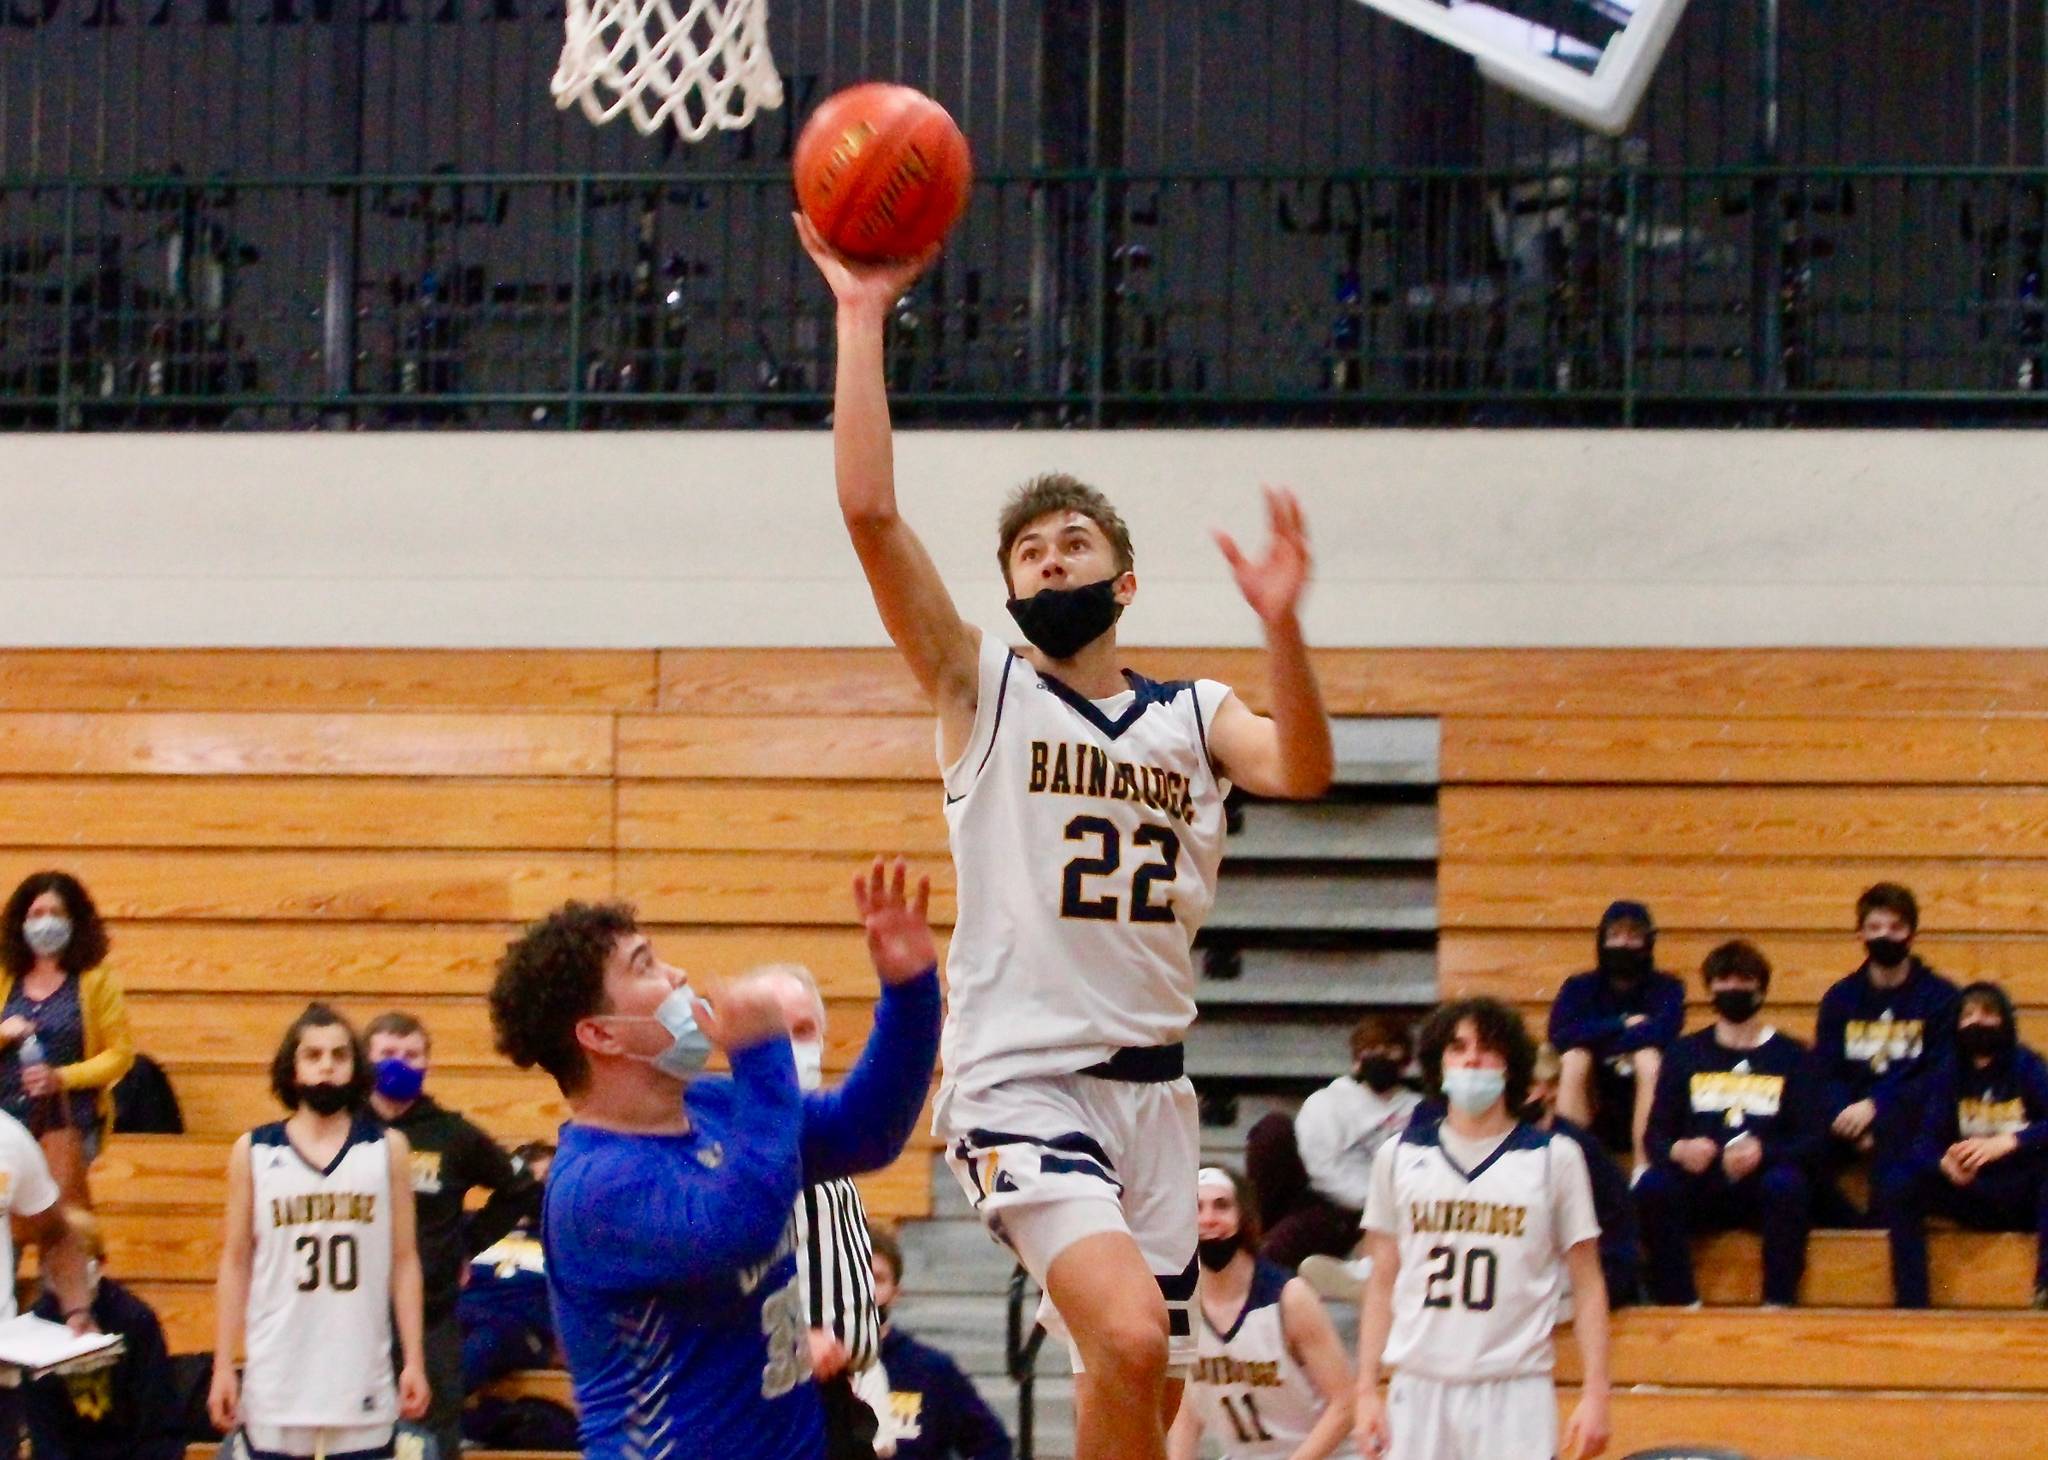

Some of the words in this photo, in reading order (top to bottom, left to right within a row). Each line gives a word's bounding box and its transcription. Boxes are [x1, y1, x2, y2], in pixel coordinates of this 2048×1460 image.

[1060, 814, 1180, 923] 22
[295, 1234, 358, 1292] 30
[1423, 1245, 1498, 1312] 20
[1219, 1392, 1275, 1443] 11
